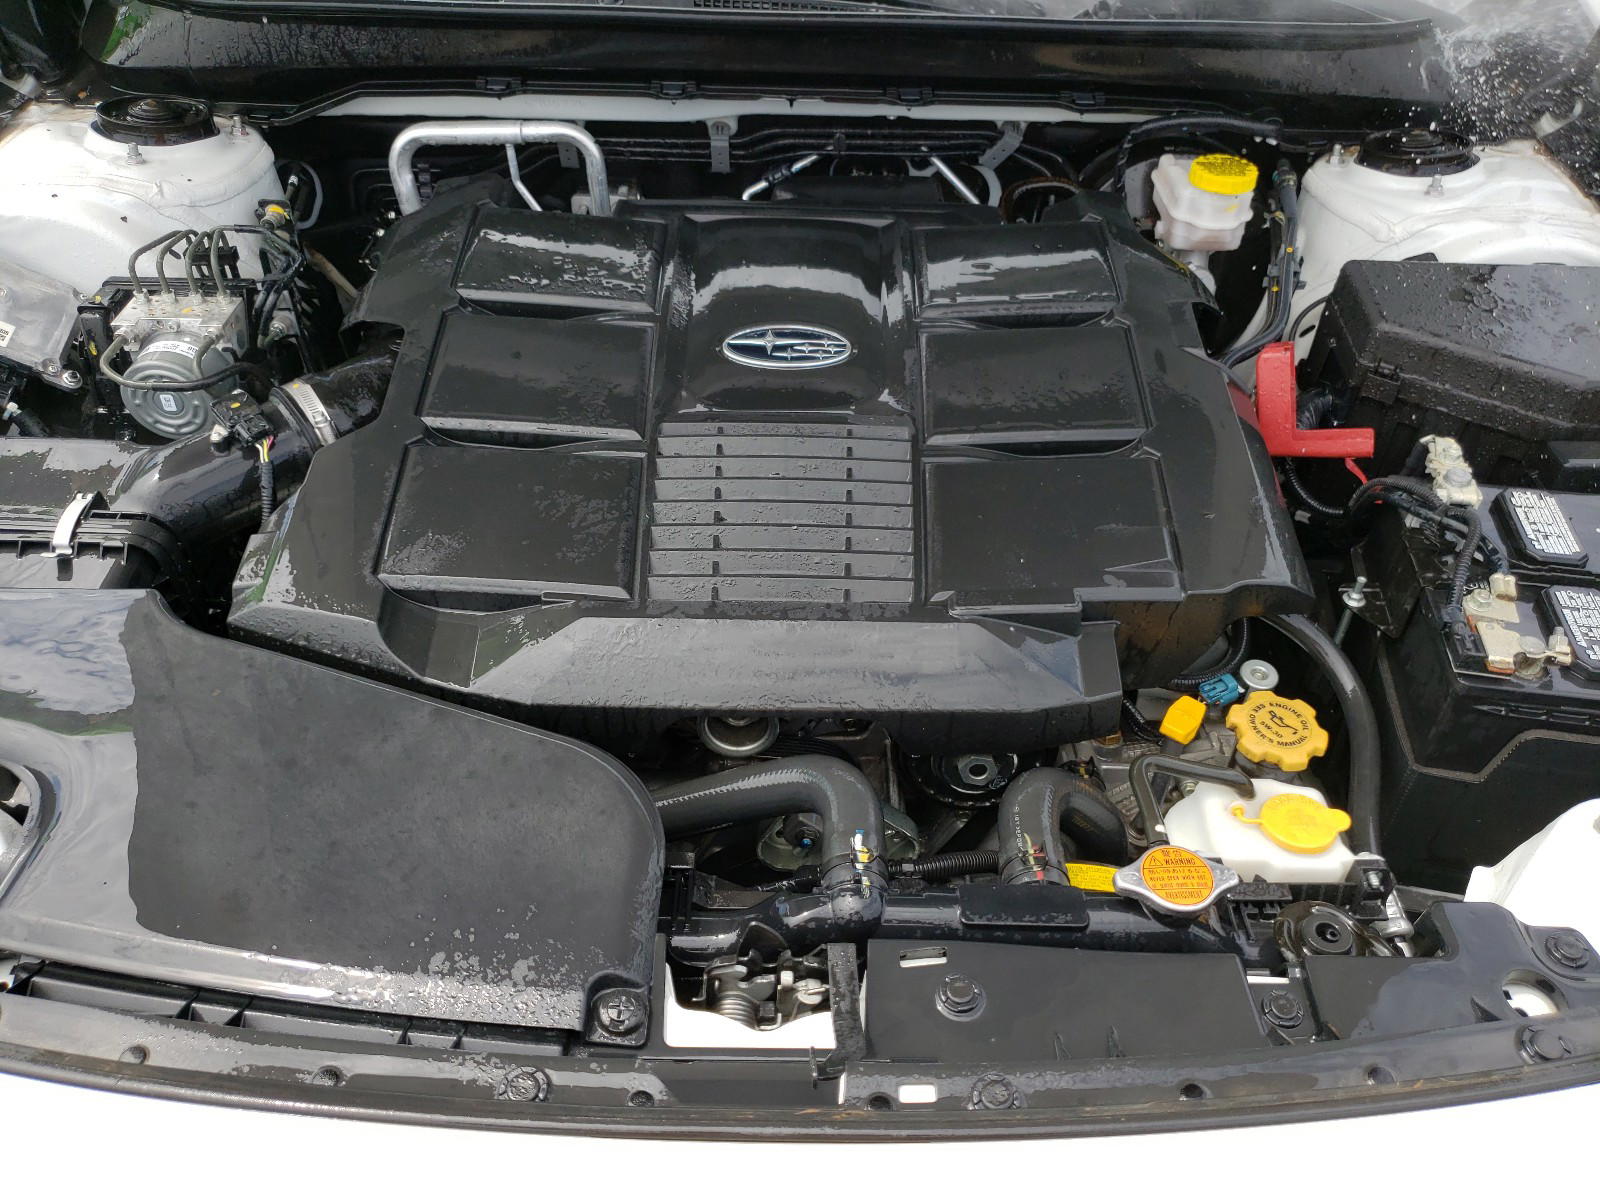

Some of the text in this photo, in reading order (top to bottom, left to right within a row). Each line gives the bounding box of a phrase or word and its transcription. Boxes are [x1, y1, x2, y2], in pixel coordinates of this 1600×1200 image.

[1249, 703, 1308, 747] SEE OWNER'S MANUAL
[1269, 702, 1309, 730] ENGINE OIL
